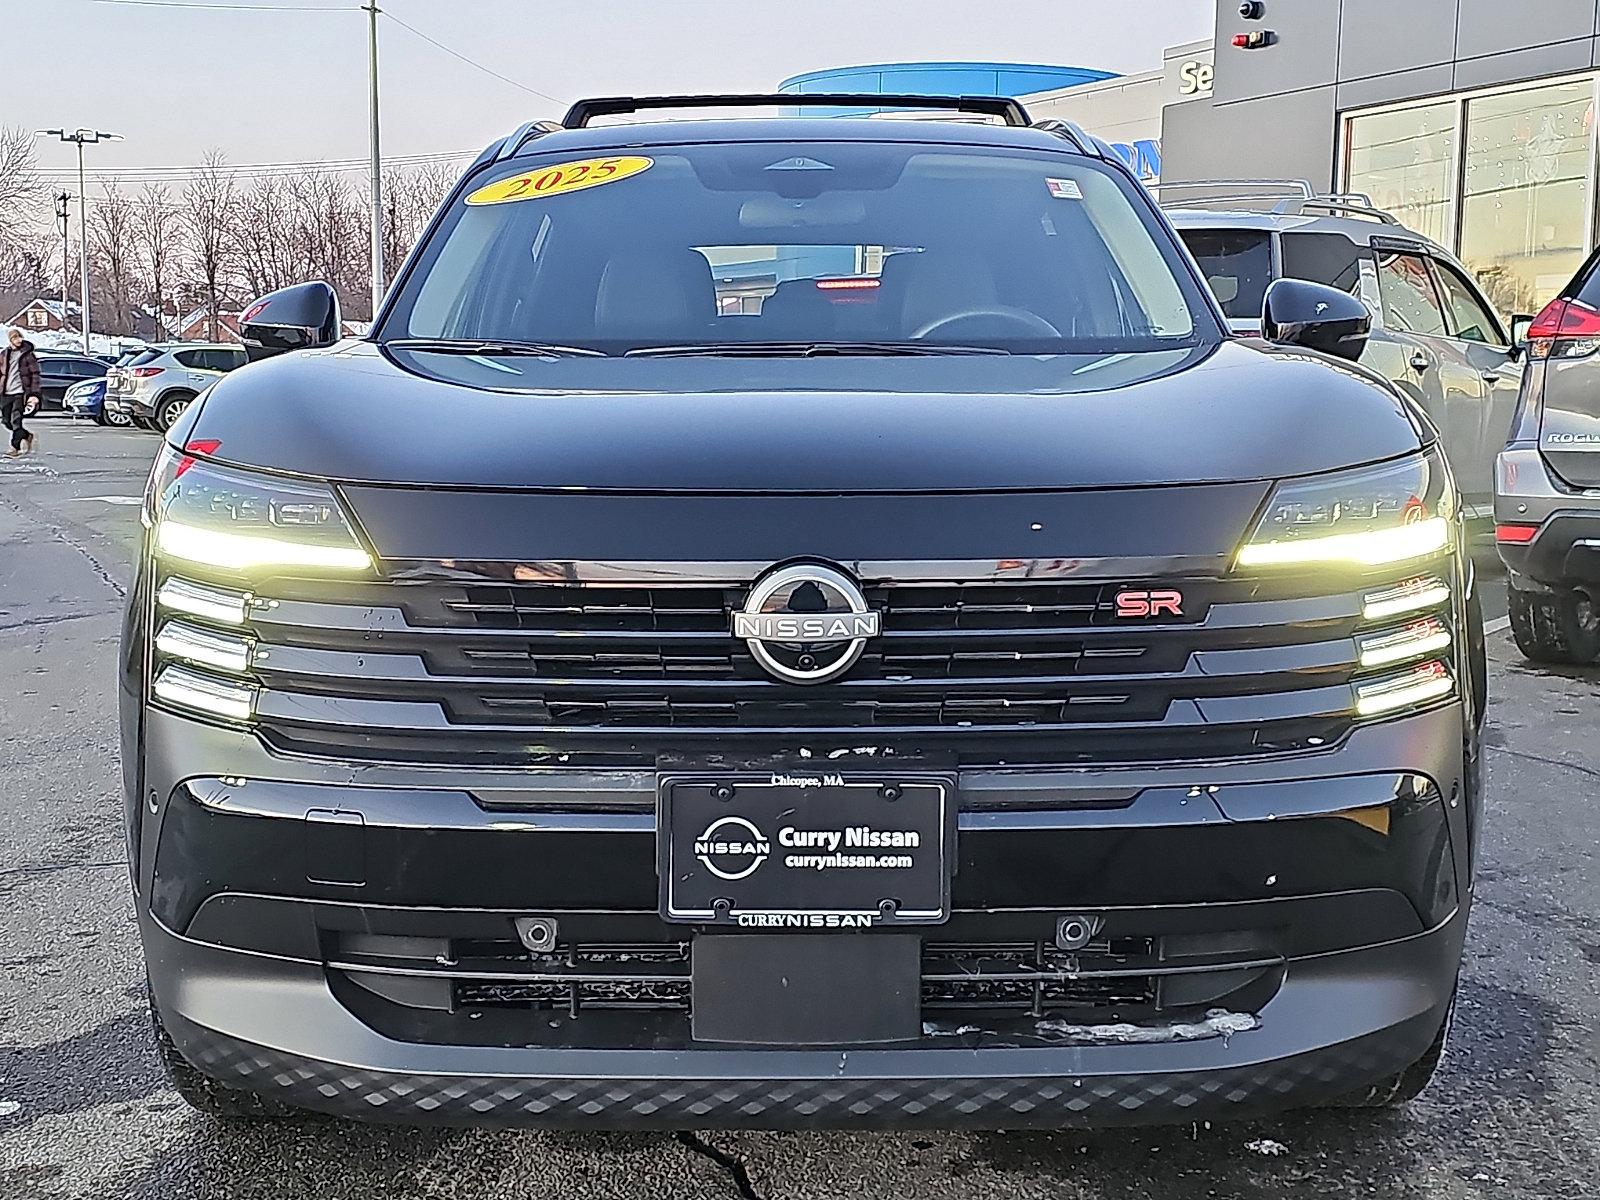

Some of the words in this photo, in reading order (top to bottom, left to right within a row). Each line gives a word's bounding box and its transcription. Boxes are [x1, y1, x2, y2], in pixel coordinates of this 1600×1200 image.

[502, 159, 622, 199] 2025
[1116, 590, 1184, 616] SR
[738, 616, 876, 637] NISSAN
[823, 774, 845, 787] MA
[694, 842, 770, 854] NISSAN
[778, 827, 842, 851] Curry
[845, 827, 919, 847] Nissan
[785, 852, 913, 870] currynissan.com
